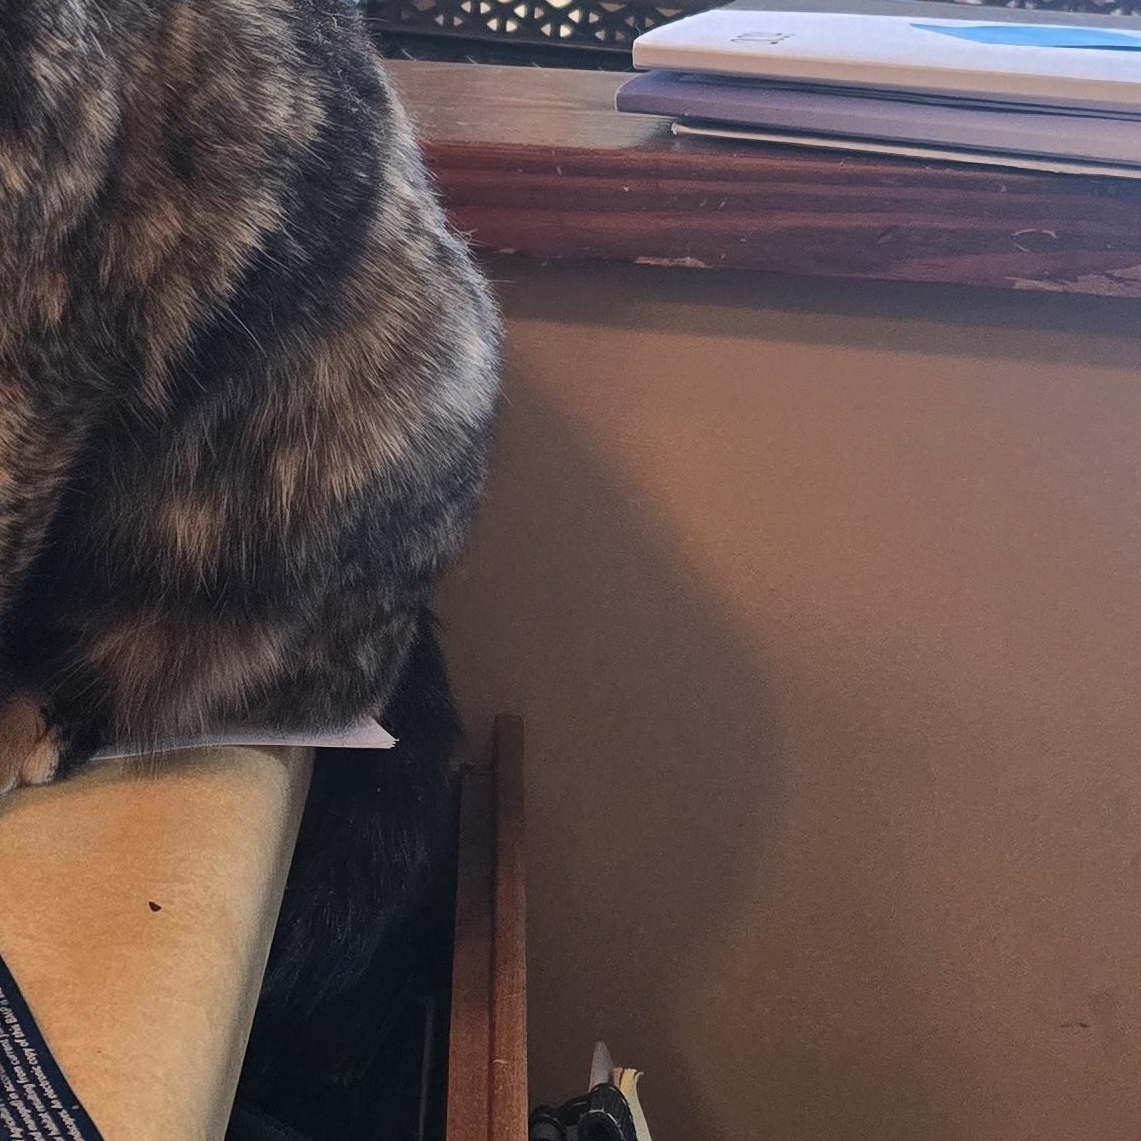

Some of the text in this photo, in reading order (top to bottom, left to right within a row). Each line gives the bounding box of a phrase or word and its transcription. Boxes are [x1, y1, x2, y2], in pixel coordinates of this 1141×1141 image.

[9, 1022, 25, 1039] this
[21, 1048, 39, 1064] copy
[12, 1065, 29, 1083] from
[29, 1064, 57, 1099] electronic
